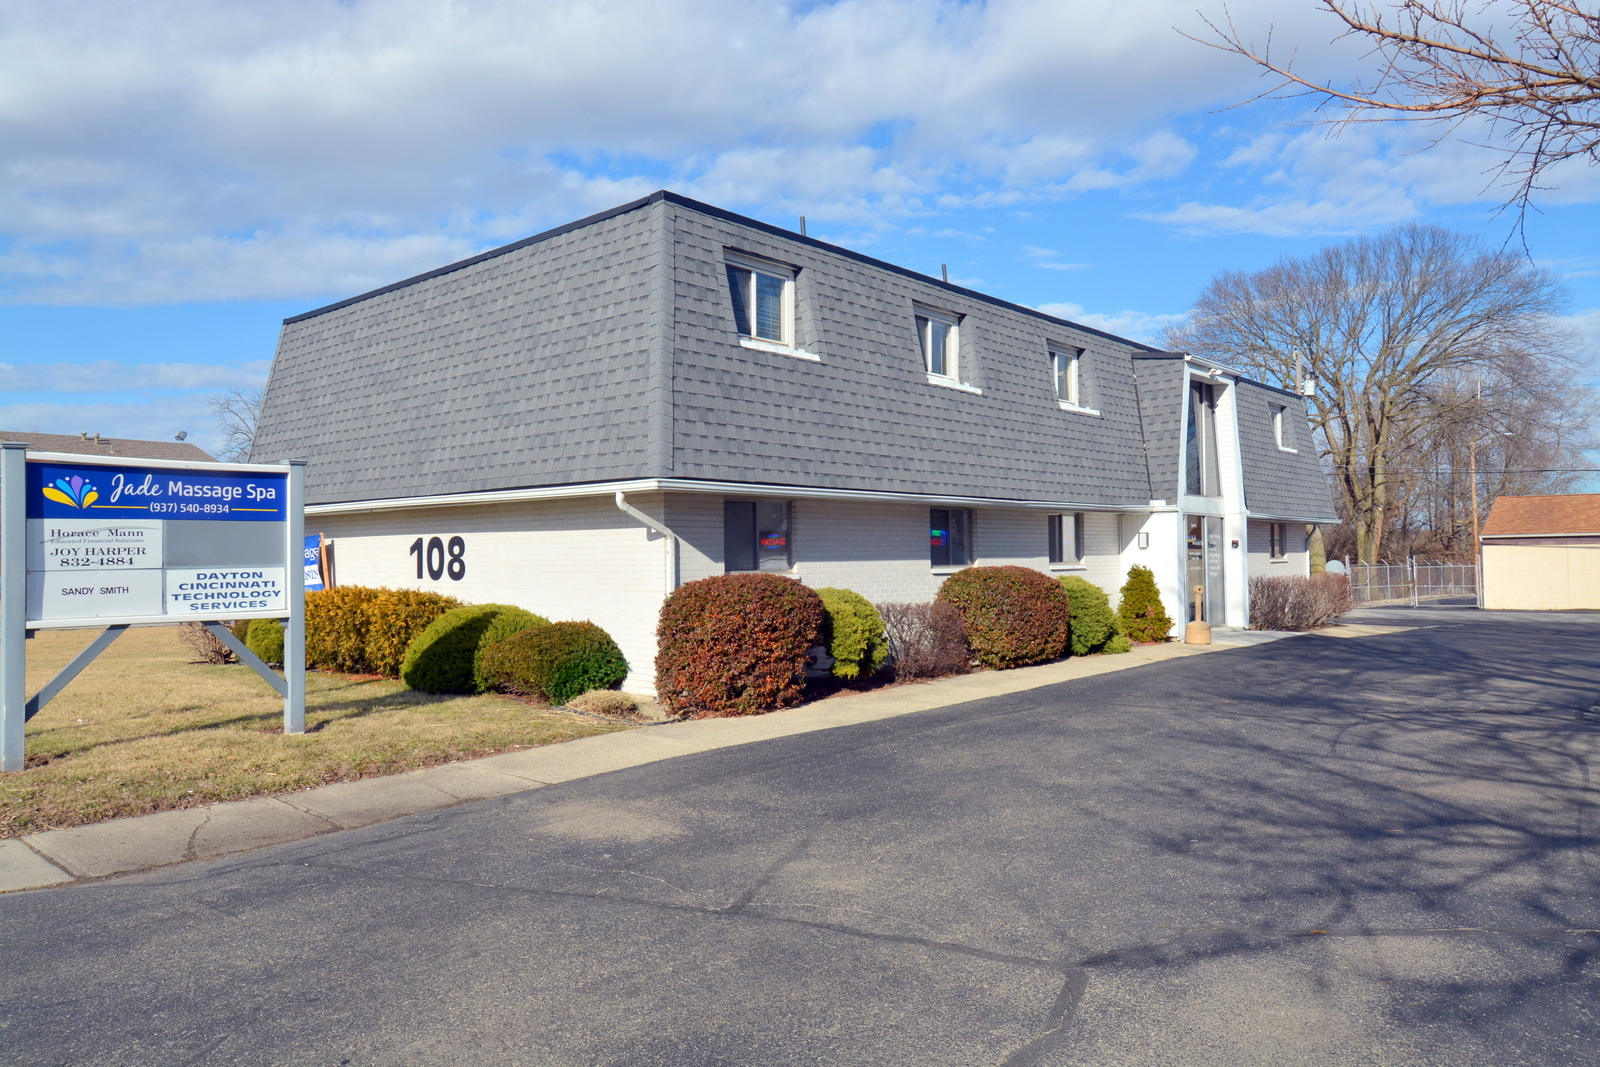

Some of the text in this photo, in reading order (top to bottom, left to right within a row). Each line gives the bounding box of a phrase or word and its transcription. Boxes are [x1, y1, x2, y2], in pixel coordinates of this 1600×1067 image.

[110, 474, 276, 502] Jade Massage Spa
[149, 502, 230, 514] (937) 540-8934
[50, 528, 144, 538] Horace Mann
[760, 537, 787, 546] MASSAGE
[50, 547, 147, 556] JOY HARPER
[60, 557, 135, 567] 832-4884
[409, 535, 466, 582] 108
[196, 571, 263, 581] DAYTON
[178, 580, 276, 591] CINCINNATI
[61, 586, 129, 596] SANDY SMITH
[171, 590, 282, 601] TECHNOLOGY
[189, 600, 268, 611] SERVICES
